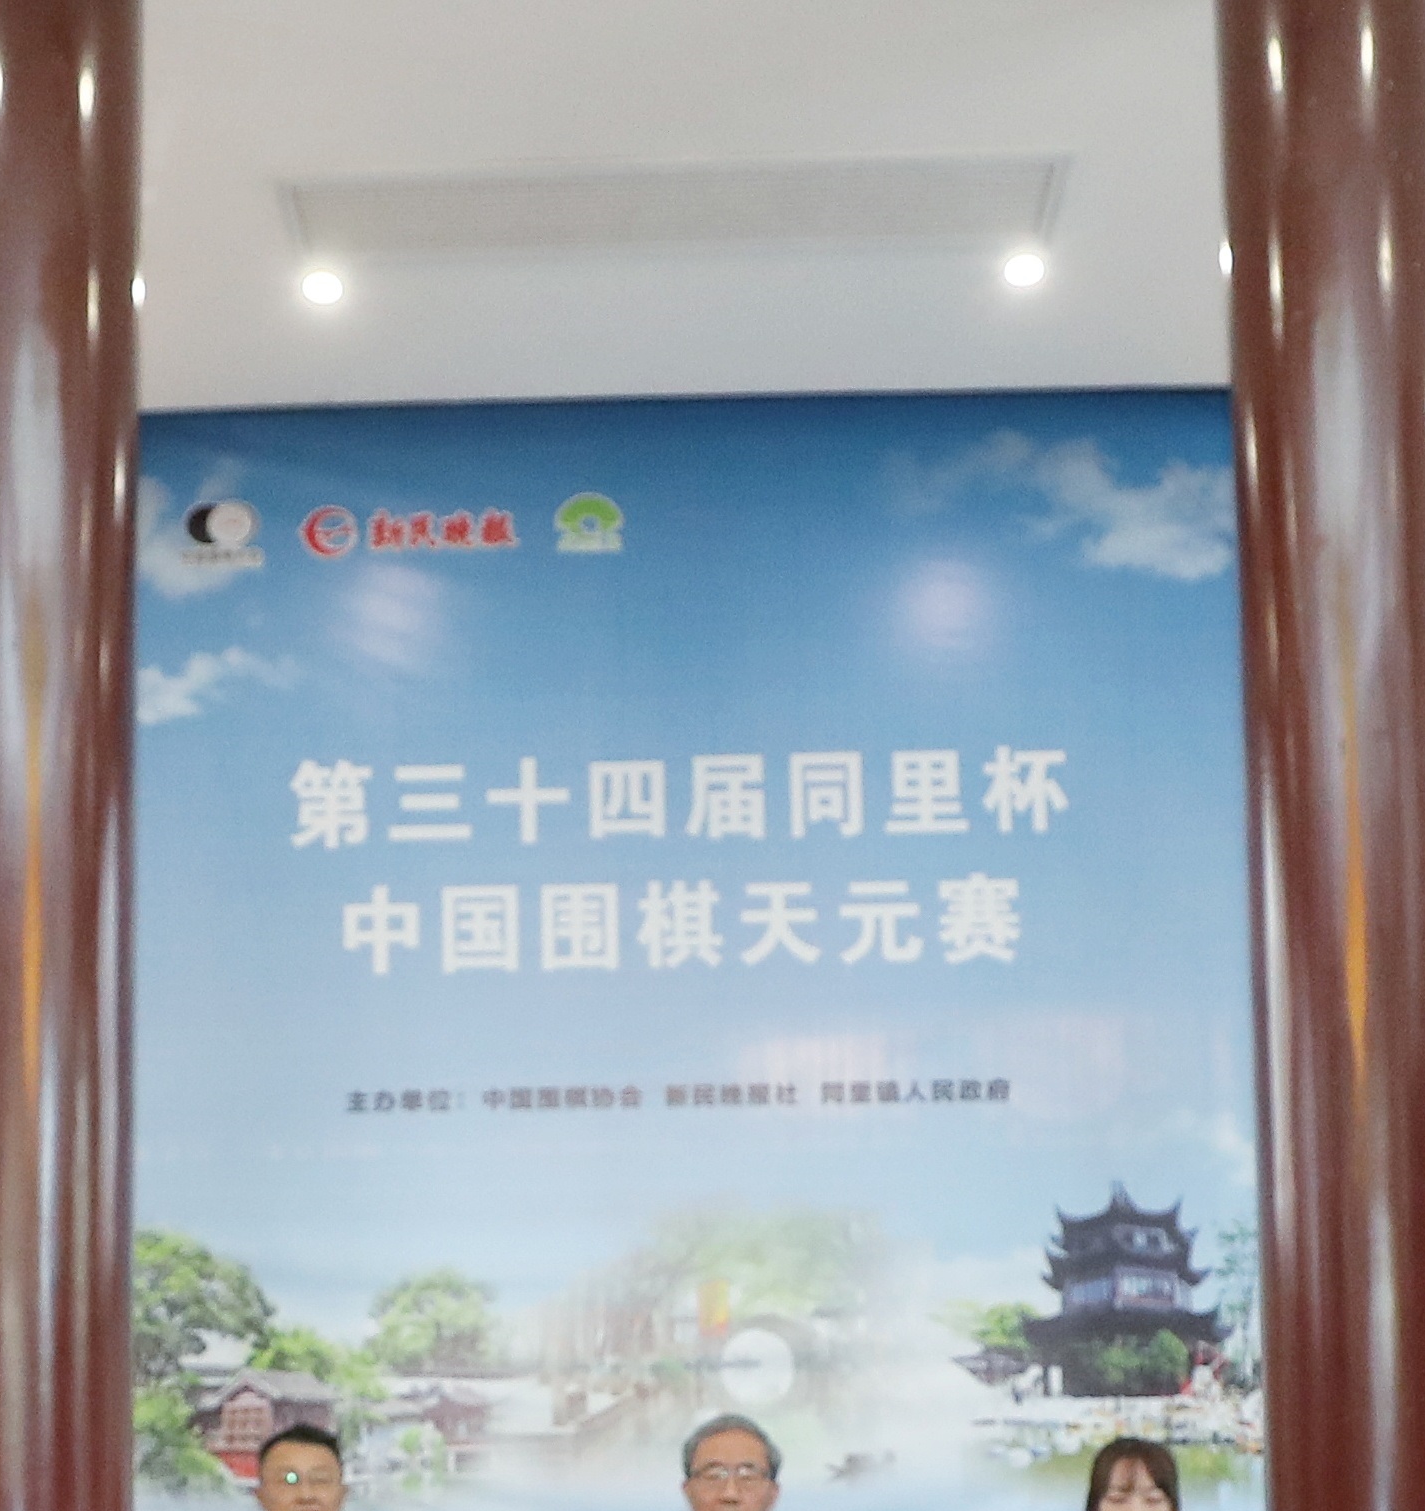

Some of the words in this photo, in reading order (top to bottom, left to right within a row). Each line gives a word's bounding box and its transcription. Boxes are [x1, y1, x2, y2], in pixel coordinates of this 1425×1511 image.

[292, 746, 1069, 848] 第三十四届同里杯
[341, 872, 1024, 975] 中国围棋天元赛
